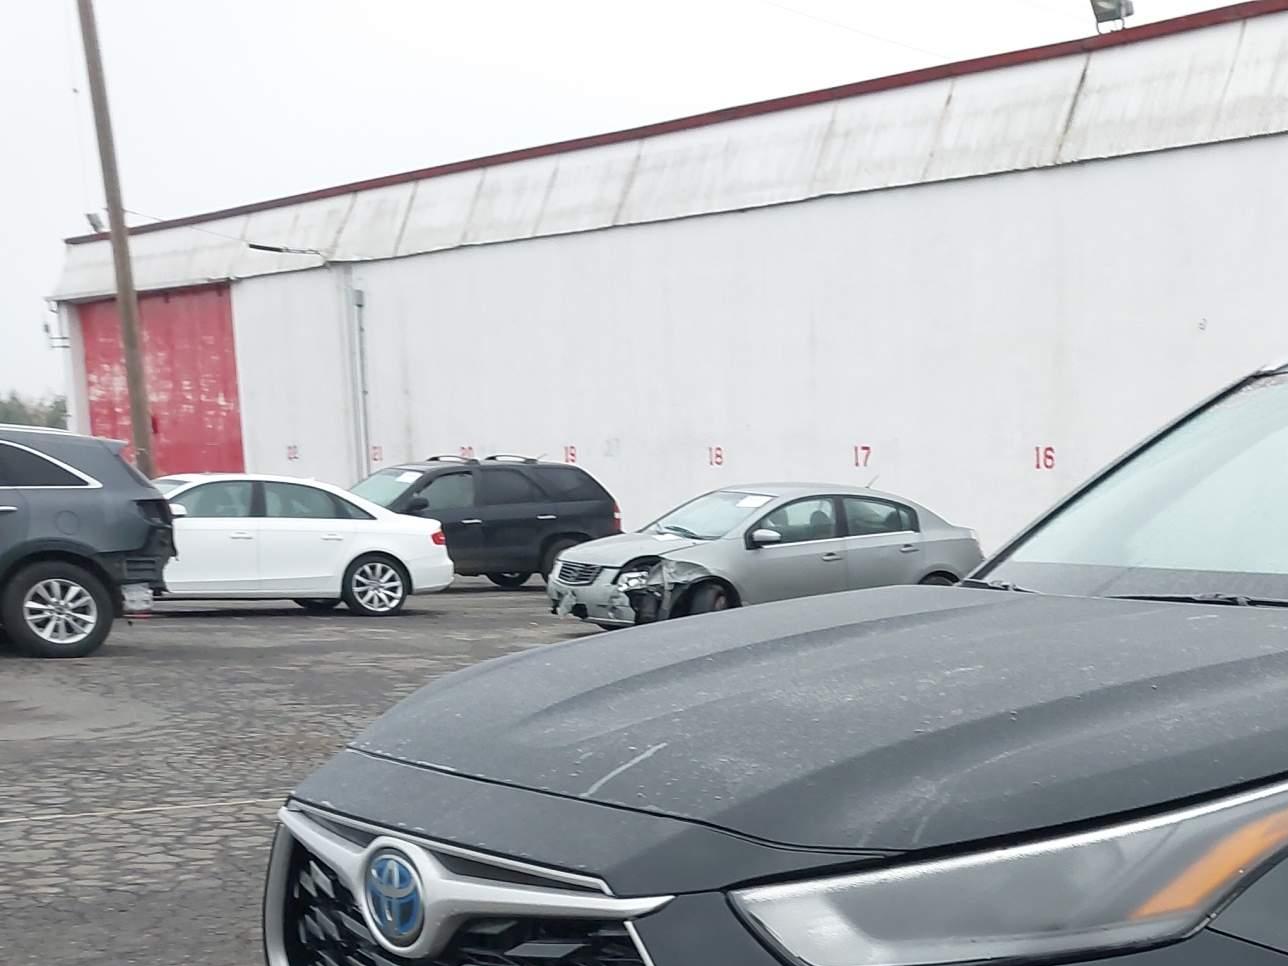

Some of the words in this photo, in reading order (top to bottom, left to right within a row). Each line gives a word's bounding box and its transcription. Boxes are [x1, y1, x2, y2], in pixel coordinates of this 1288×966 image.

[707, 446, 724, 467] 18
[853, 445, 872, 468] 17
[1034, 445, 1056, 470] 16
